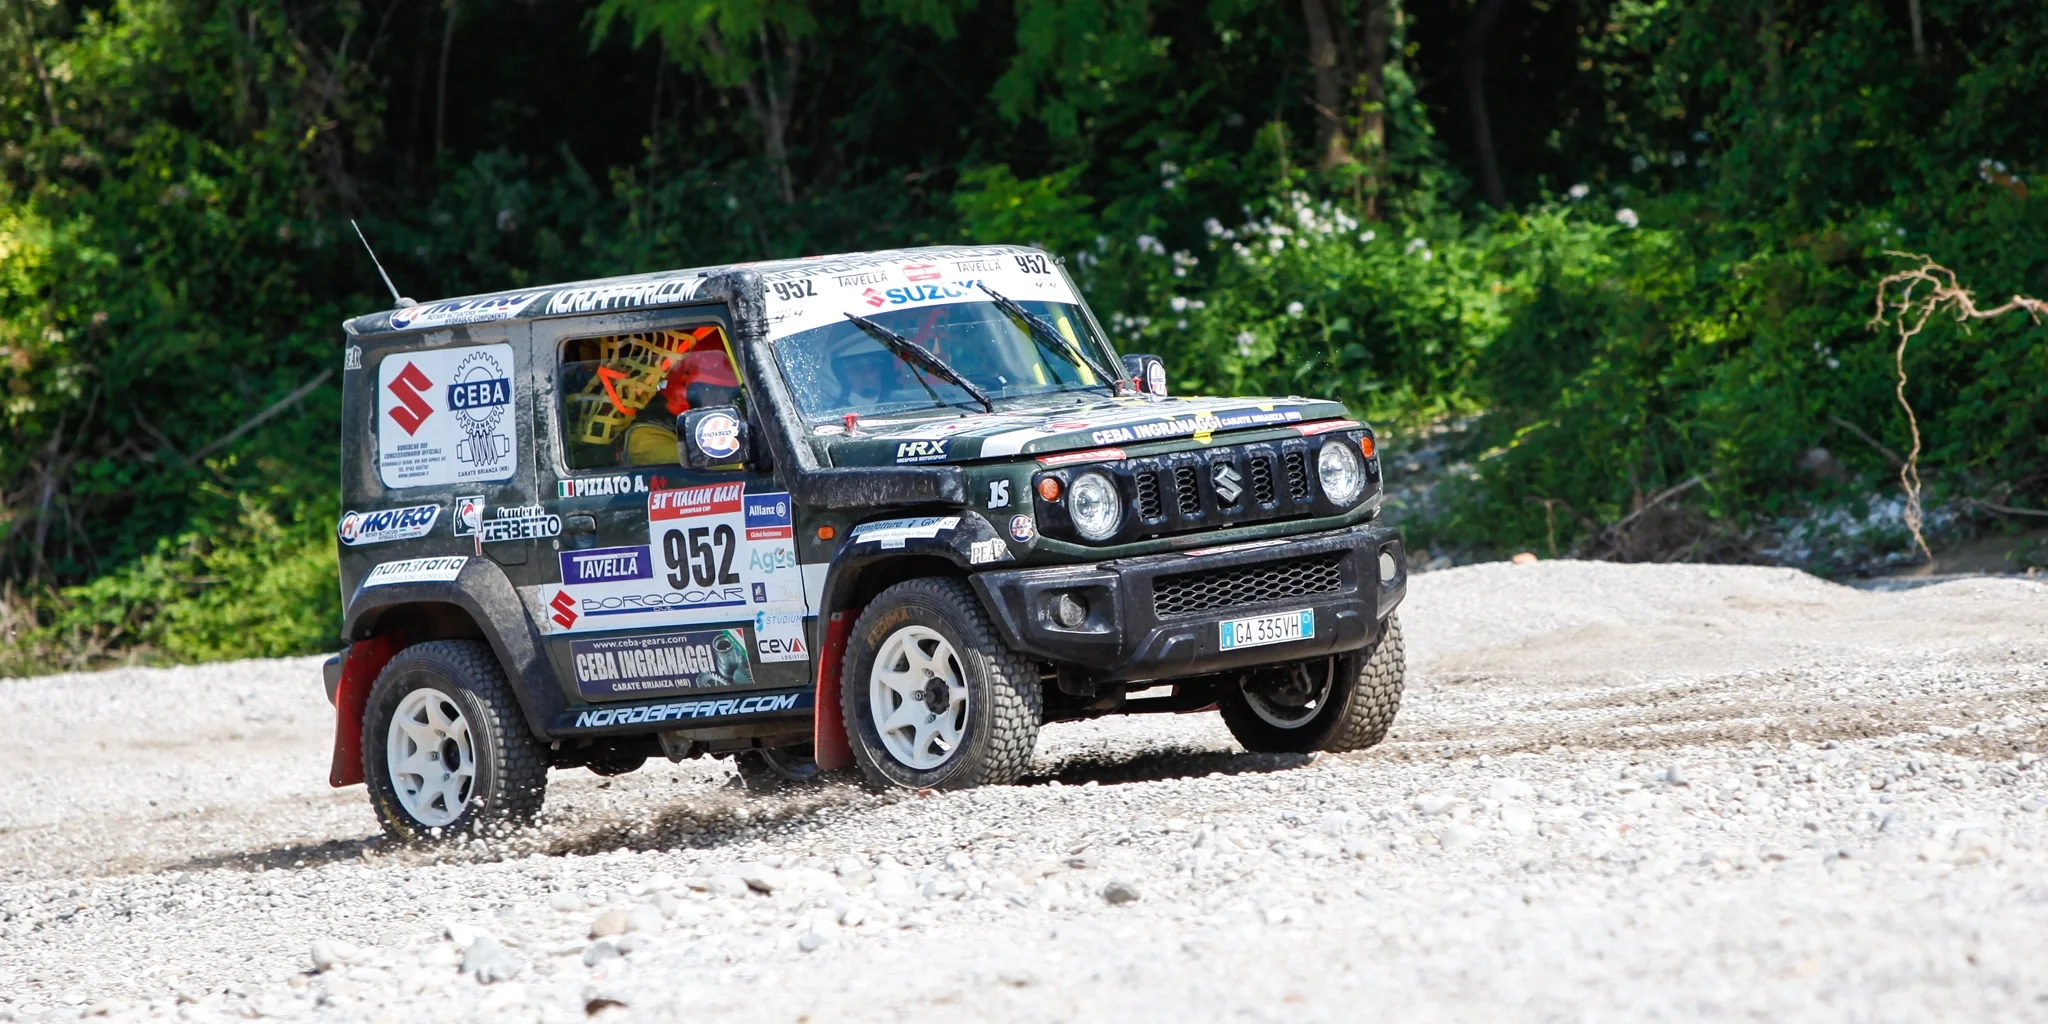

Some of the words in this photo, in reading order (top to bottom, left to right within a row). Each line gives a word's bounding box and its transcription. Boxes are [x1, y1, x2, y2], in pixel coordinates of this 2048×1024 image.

[951, 259, 1002, 273] TAVELLA
[1014, 255, 1052, 275] 952
[832, 270, 889, 287] TAVELLA
[773, 279, 818, 301] 952
[453, 382, 504, 408] CEBA
[1092, 428, 1131, 445] CEBA
[1132, 416, 1223, 439] INGRANAGGI
[897, 440, 948, 457] HRX
[457, 470, 477, 478] CARATE
[477, 467, 498, 475] BRIANZA
[575, 476, 631, 497] PIZZATO
[634, 475, 649, 493] A.
[672, 487, 713, 508] ITALIAN
[713, 485, 740, 503] BAJA
[359, 506, 436, 534] MOVECO
[749, 504, 776, 517] Allianz
[483, 516, 560, 540] ZERBETTO
[854, 520, 904, 536] Manifattura
[573, 551, 639, 579] TAVELLA
[663, 523, 741, 590] 952
[582, 587, 745, 611] BORGOCAR
[766, 614, 802, 625] STUDIUM
[1236, 623, 1253, 644] GA
[1257, 614, 1299, 640] 335VH
[592, 635, 688, 650] www.ceba-gears.com
[576, 650, 620, 683] CEBA
[619, 644, 715, 679] INGRANAGGI
[612, 680, 640, 691] CARATE
[640, 679, 674, 690] BRIANZA
[674, 678, 692, 689] (MB)
[575, 694, 800, 728] NORDAFFARI.COM
